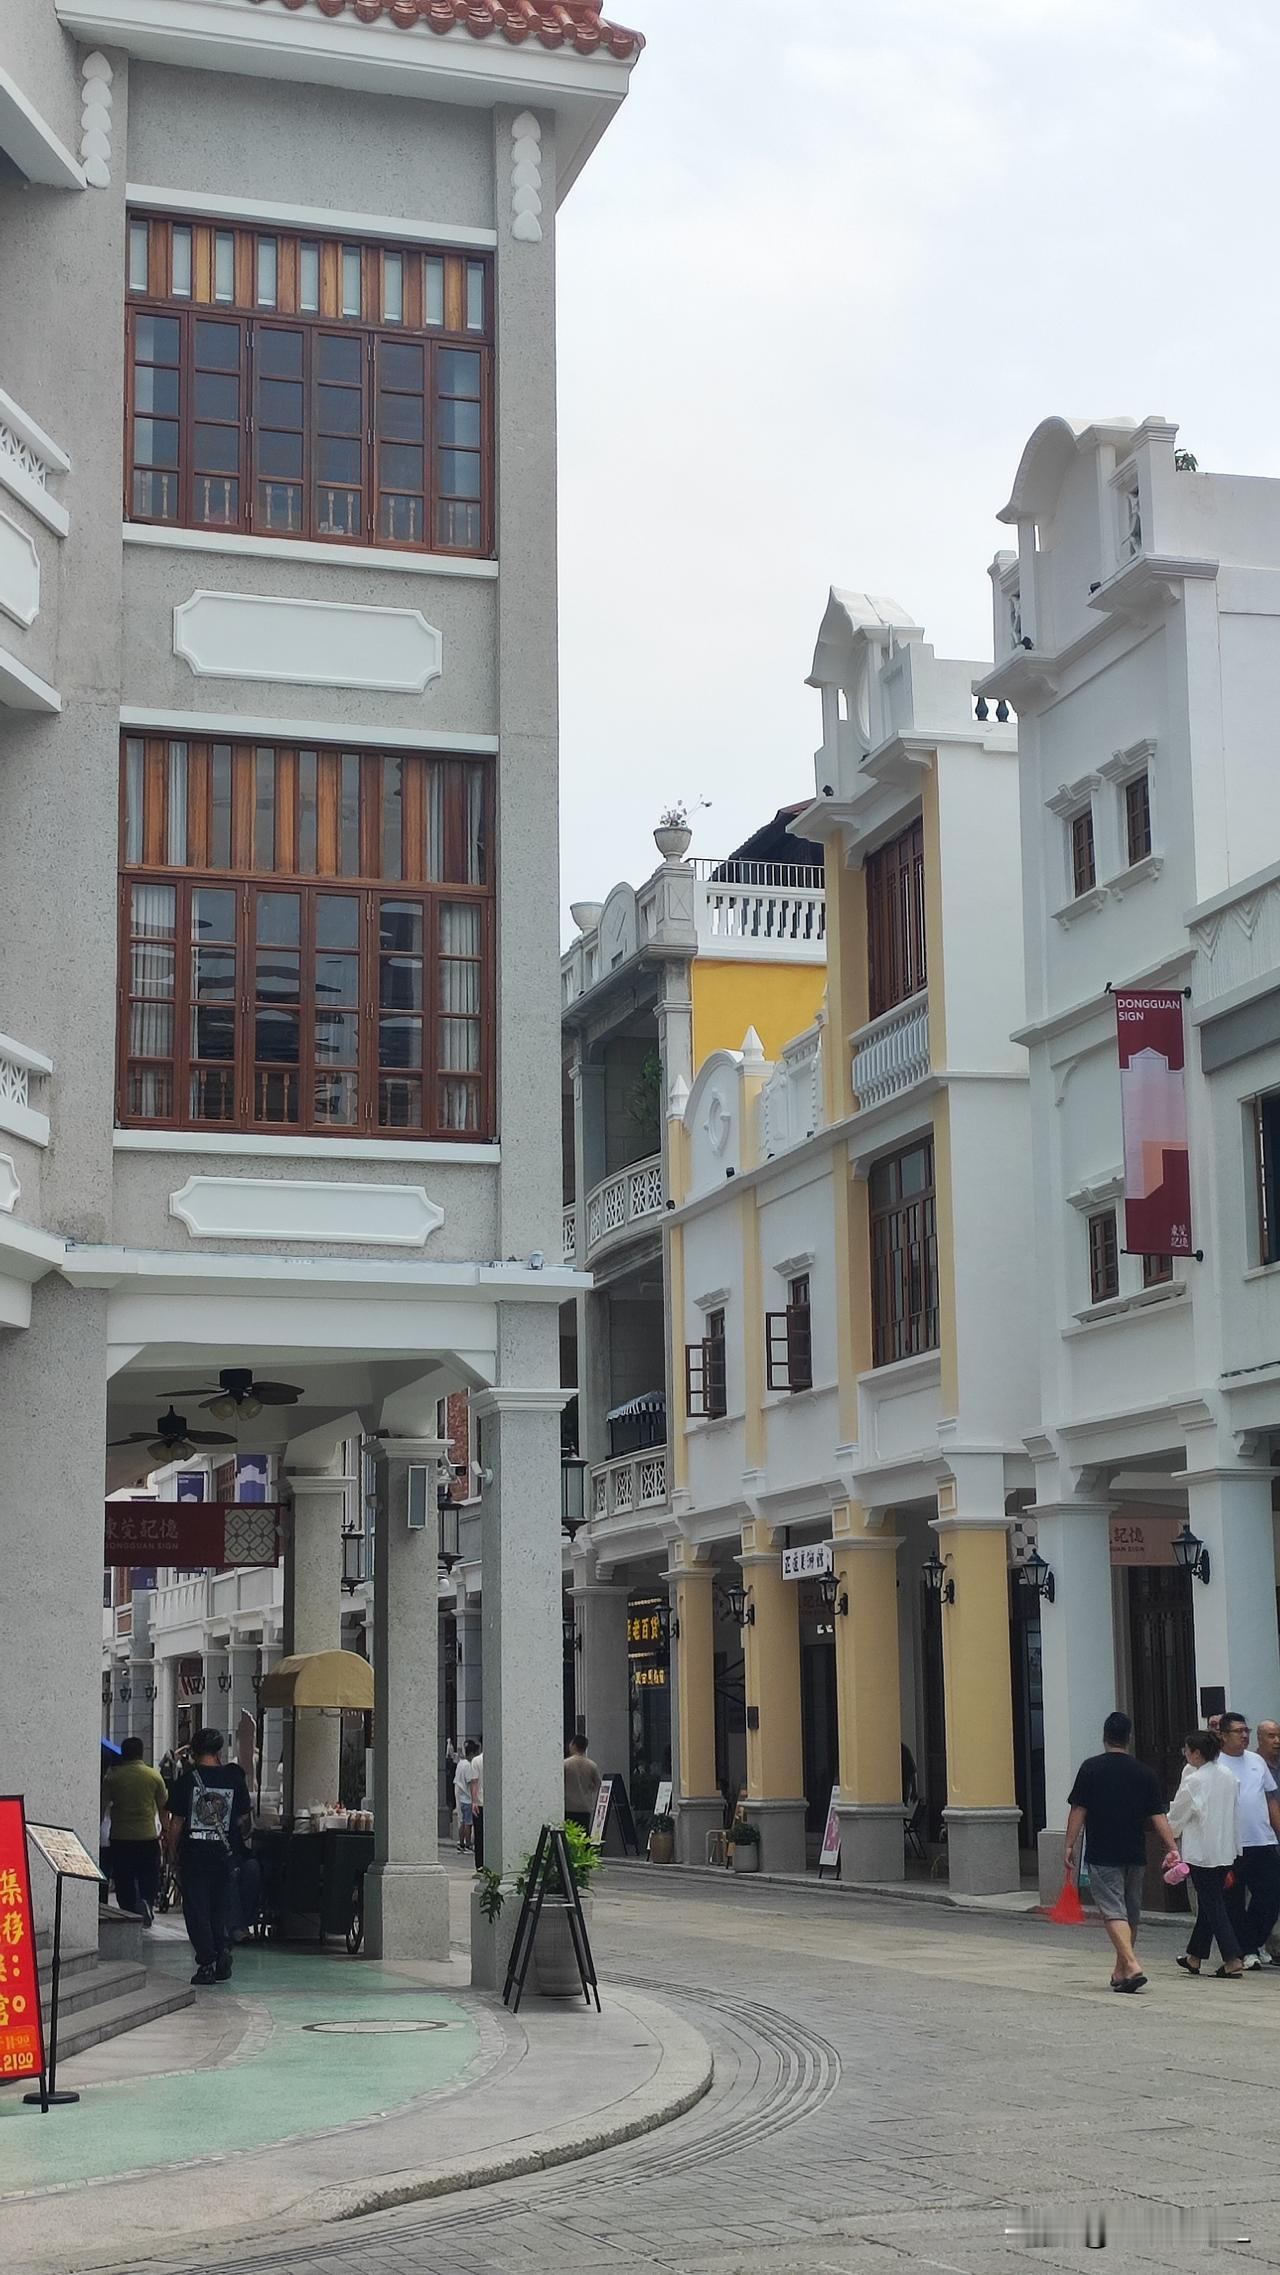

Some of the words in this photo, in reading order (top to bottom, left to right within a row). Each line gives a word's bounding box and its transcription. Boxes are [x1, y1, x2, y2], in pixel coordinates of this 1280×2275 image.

[1117, 999, 1180, 1009] DONGGUAN
[1118, 1011, 1144, 1021] SIGN
[1110, 1526, 1145, 1544] 記憶
